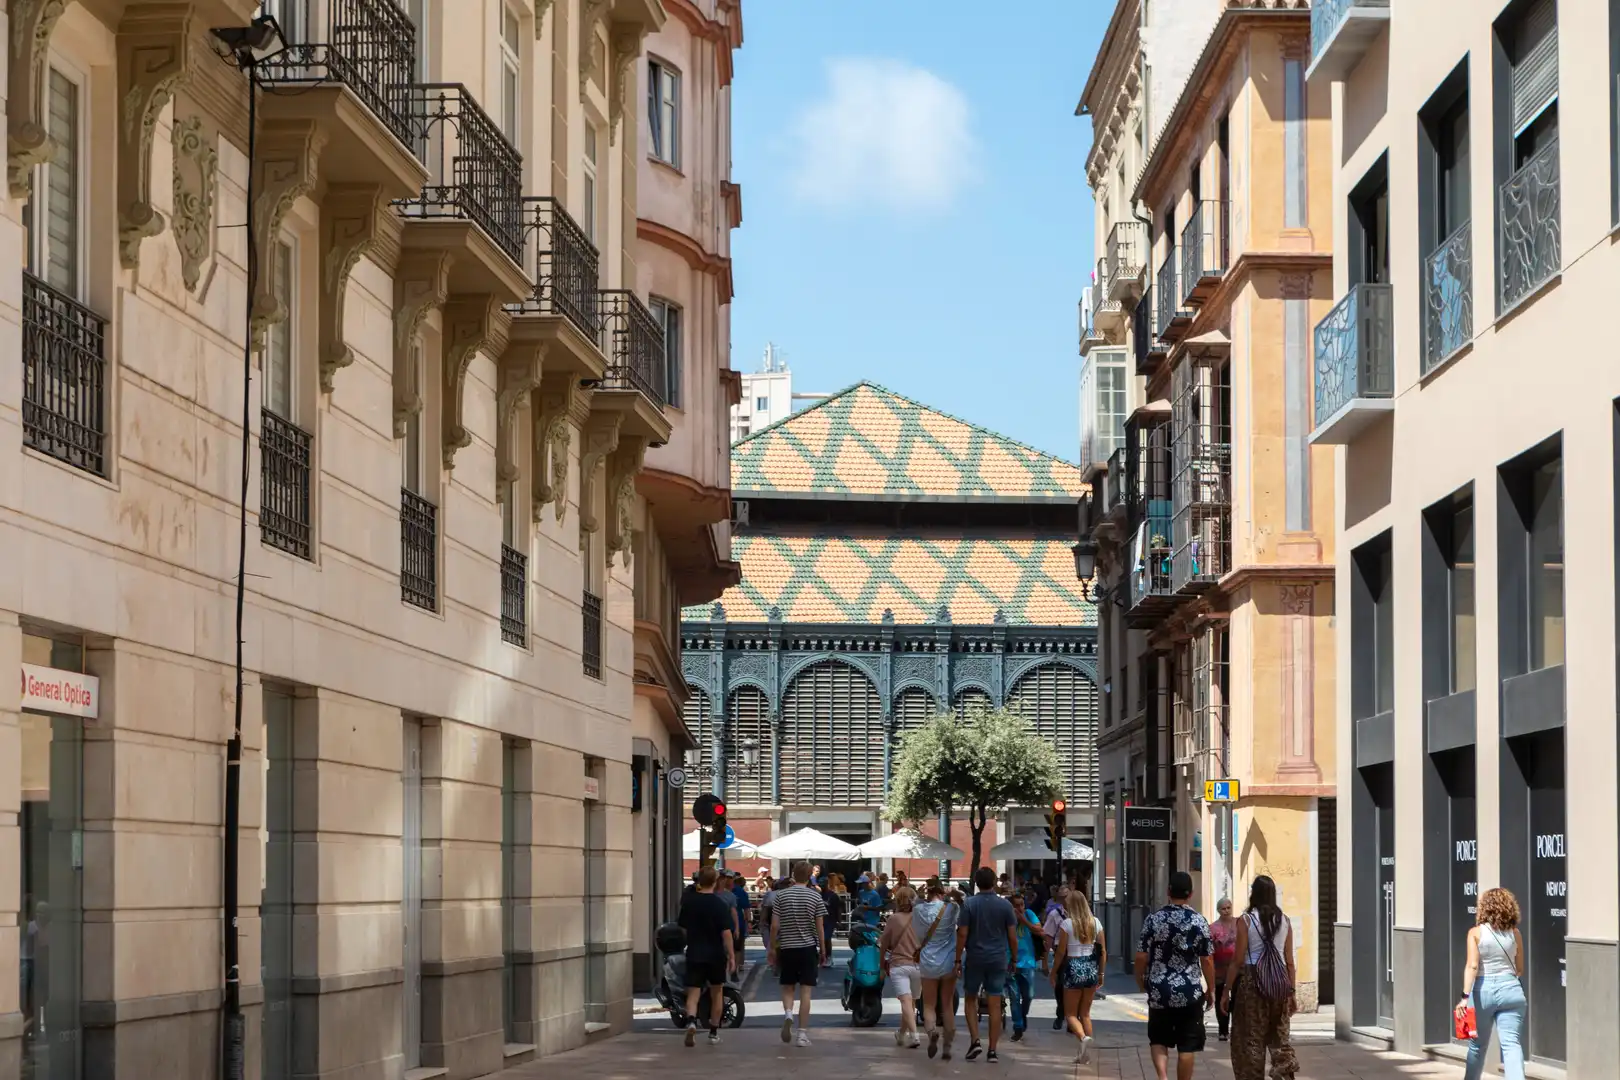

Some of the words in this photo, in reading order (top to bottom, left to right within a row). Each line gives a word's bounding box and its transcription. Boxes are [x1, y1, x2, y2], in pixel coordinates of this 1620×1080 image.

[28, 675, 62, 701] General
[64, 682, 91, 708] Optica
[1215, 782, 1222, 799] P
[1456, 840, 1477, 861] PORCE
[1536, 834, 1566, 858] PORCEL
[1463, 882, 1474, 896] NEW
[1546, 881, 1559, 897] NEW
